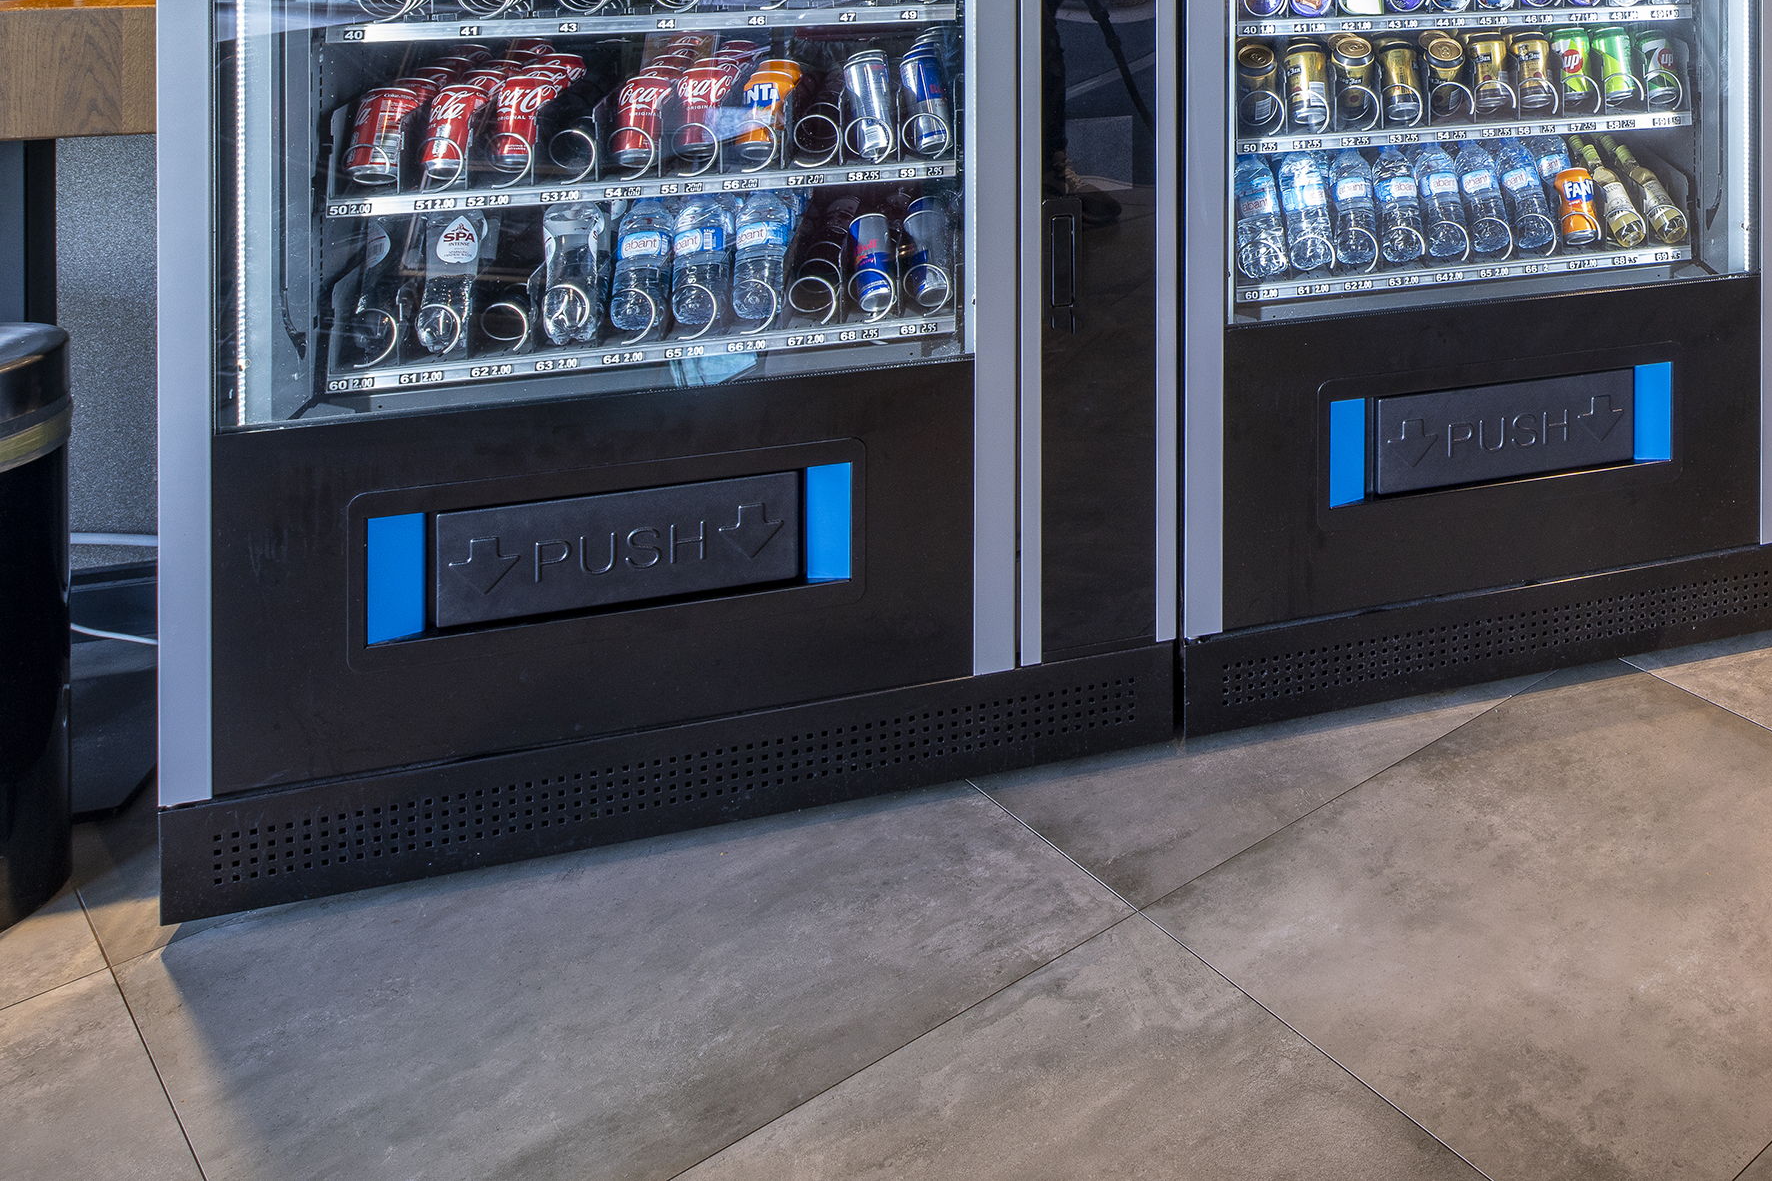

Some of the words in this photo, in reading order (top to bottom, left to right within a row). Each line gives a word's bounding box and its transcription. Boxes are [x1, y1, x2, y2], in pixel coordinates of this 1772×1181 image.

[657, 19, 675, 29] 44
[461, 26, 478, 36] 41
[1564, 55, 1580, 70] up
[1433, 179, 1455, 188] abant
[1564, 179, 1594, 197] FANT
[541, 192, 559, 201] 53
[560, 191, 579, 201] 2.00
[330, 205, 347, 215] 50
[350, 204, 370, 214] 2.00
[416, 200, 433, 210] 51
[435, 199, 455, 209] 2.00
[443, 232, 475, 243] SPA
[624, 237, 657, 252] abant
[1404, 277, 1419, 285] 2.00
[1315, 285, 1329, 293] 2.00
[666, 347, 682, 357] 65
[687, 346, 703, 356] 2.00
[536, 360, 553, 370] 63
[559, 359, 577, 369] 2.00
[401, 374, 417, 384] 61
[423, 372, 442, 382] 2.00
[330, 381, 347, 390] 60
[353, 378, 373, 389] 2.00
[1448, 409, 1569, 458] PUSH
[534, 520, 708, 583] PUSH
